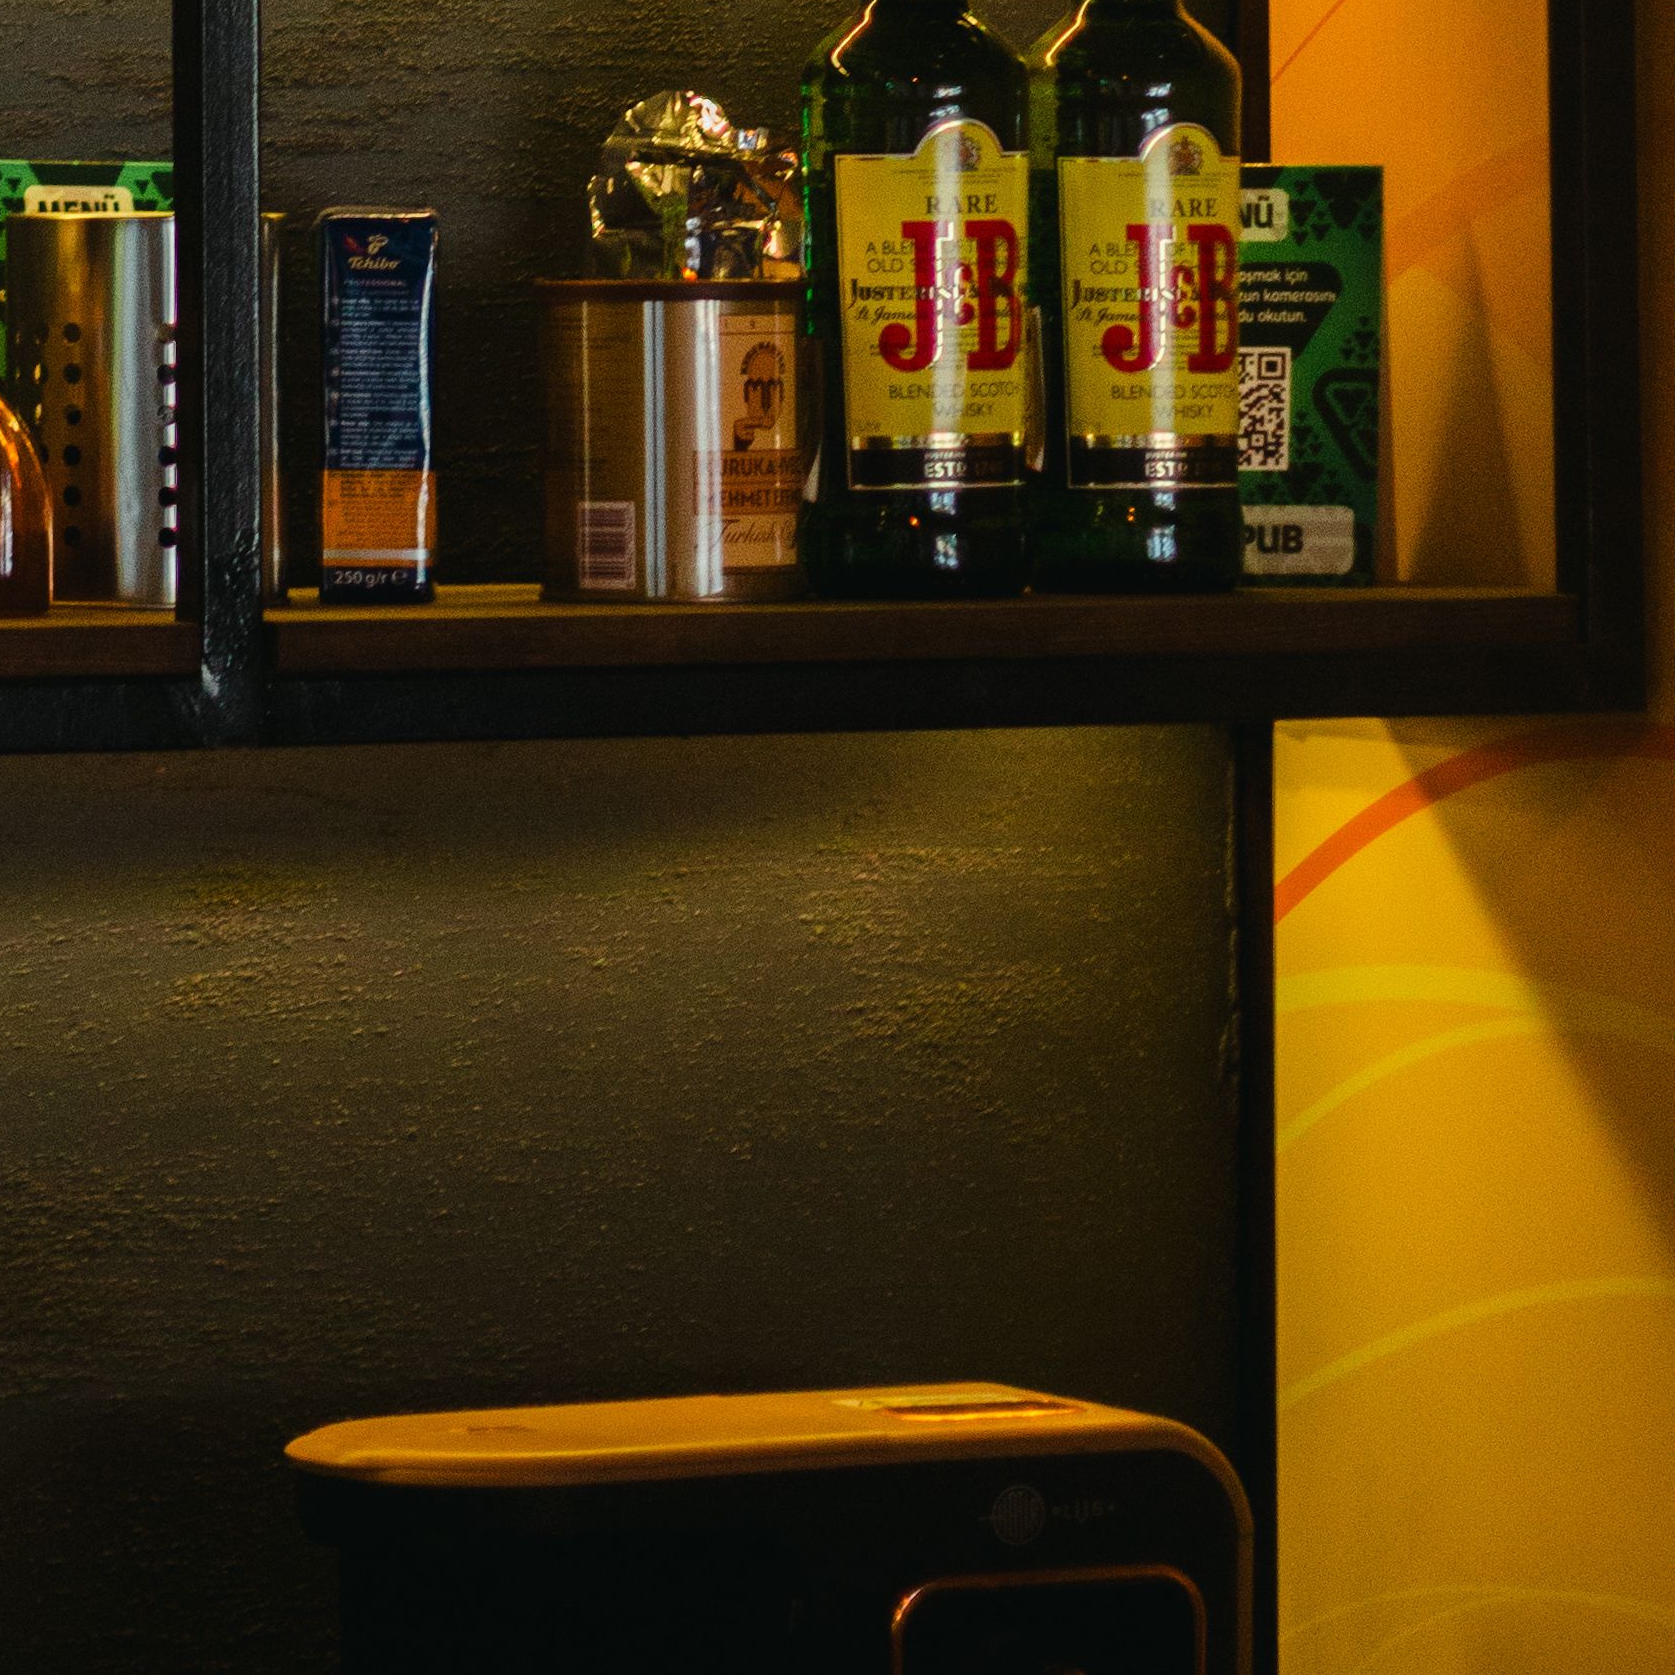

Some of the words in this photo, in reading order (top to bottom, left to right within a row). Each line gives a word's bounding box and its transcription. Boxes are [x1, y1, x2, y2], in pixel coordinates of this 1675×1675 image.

[925, 194, 997, 215] RARE
[1149, 198, 1218, 218] RARE
[347, 255, 403, 270] Tchibo
[867, 257, 904, 273] OLD
[878, 218, 1023, 373] J&B
[1101, 223, 1238, 374] J&B
[334, 569, 364, 585] 250
